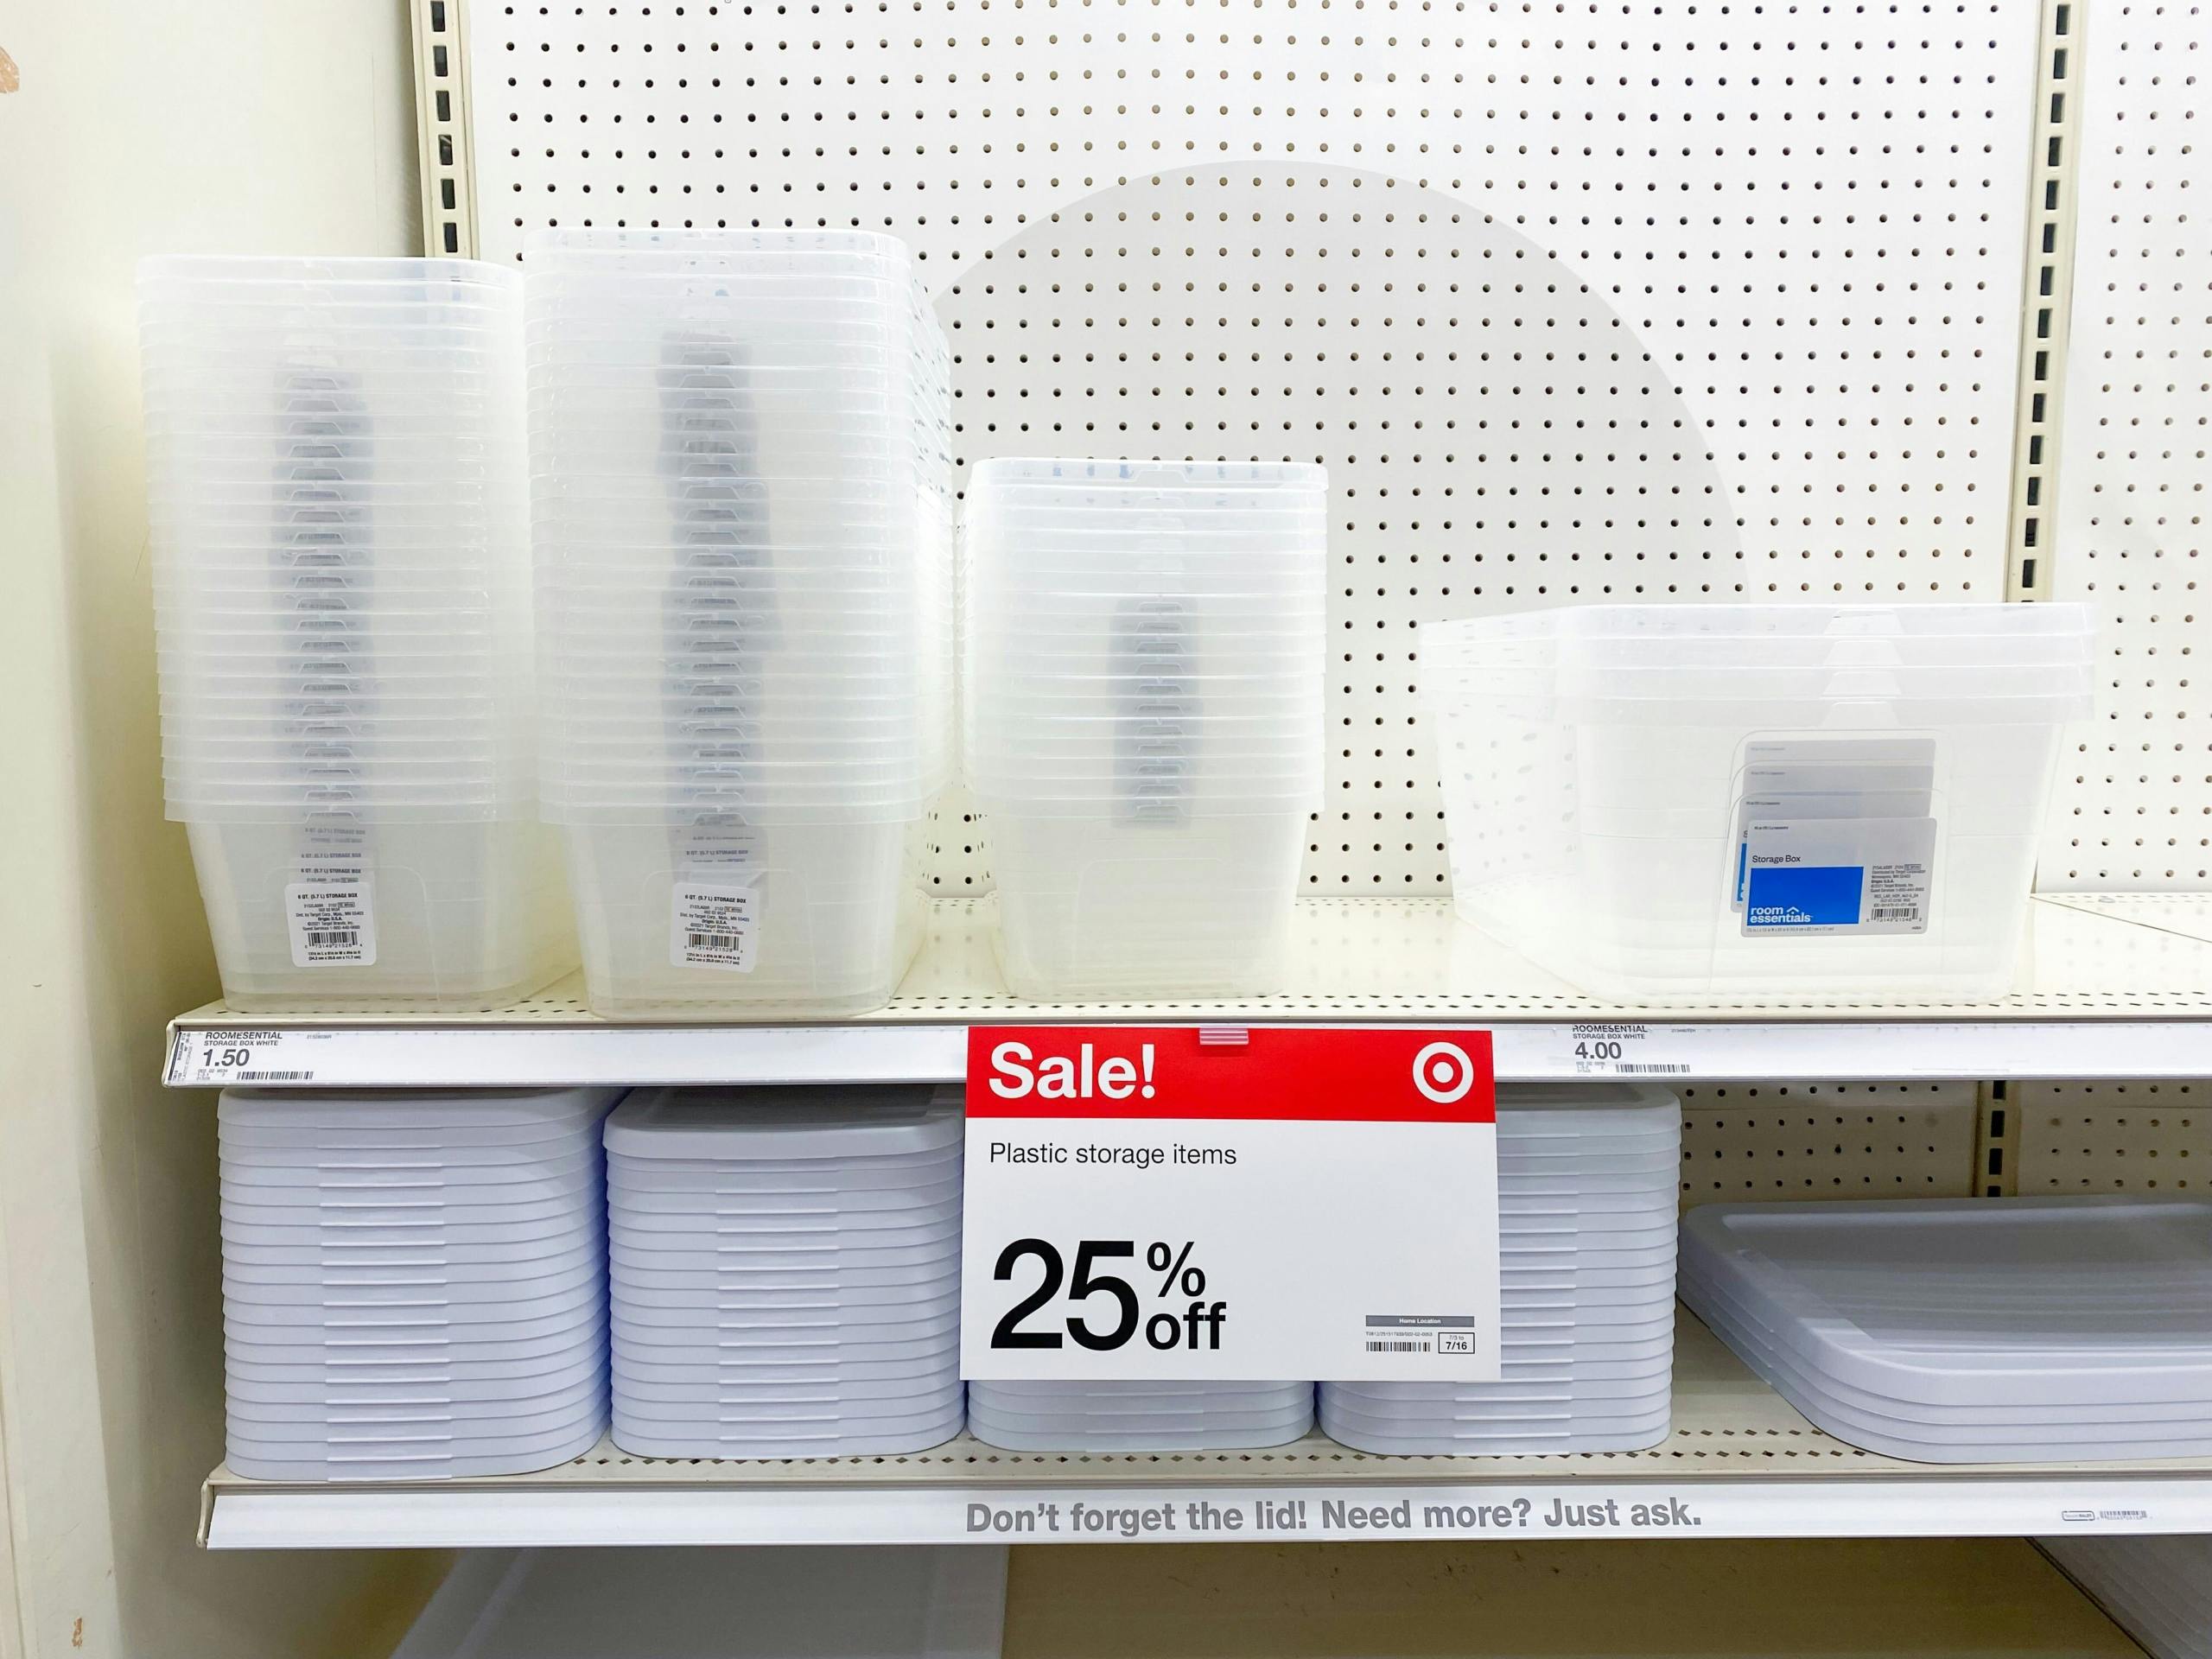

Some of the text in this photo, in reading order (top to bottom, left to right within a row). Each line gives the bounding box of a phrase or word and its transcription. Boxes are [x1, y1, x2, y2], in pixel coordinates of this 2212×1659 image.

[1751, 855, 1783, 864] Storage
[1750, 912, 1811, 923] essentials
[1751, 906, 1783, 915] room
[203, 1048, 250, 1066] 1.50
[1575, 1042, 1622, 1059] 4.00
[988, 1041, 1156, 1099] Sale!
[990, 1142, 1237, 1169] Plastic storage items
[990, 1237, 1206, 1351] 25 %
[1145, 1300, 1227, 1351] off
[1446, 1341, 1467, 1351] 7/16
[1070, 1502, 1176, 1535] forget
[1186, 1501, 1244, 1530] the
[1255, 1501, 1307, 1529] lid!
[1321, 1501, 1412, 1529] Need
[1423, 1499, 1532, 1528] more?
[1544, 1498, 1621, 1528] Just
[1630, 1497, 1702, 1527] ask.
